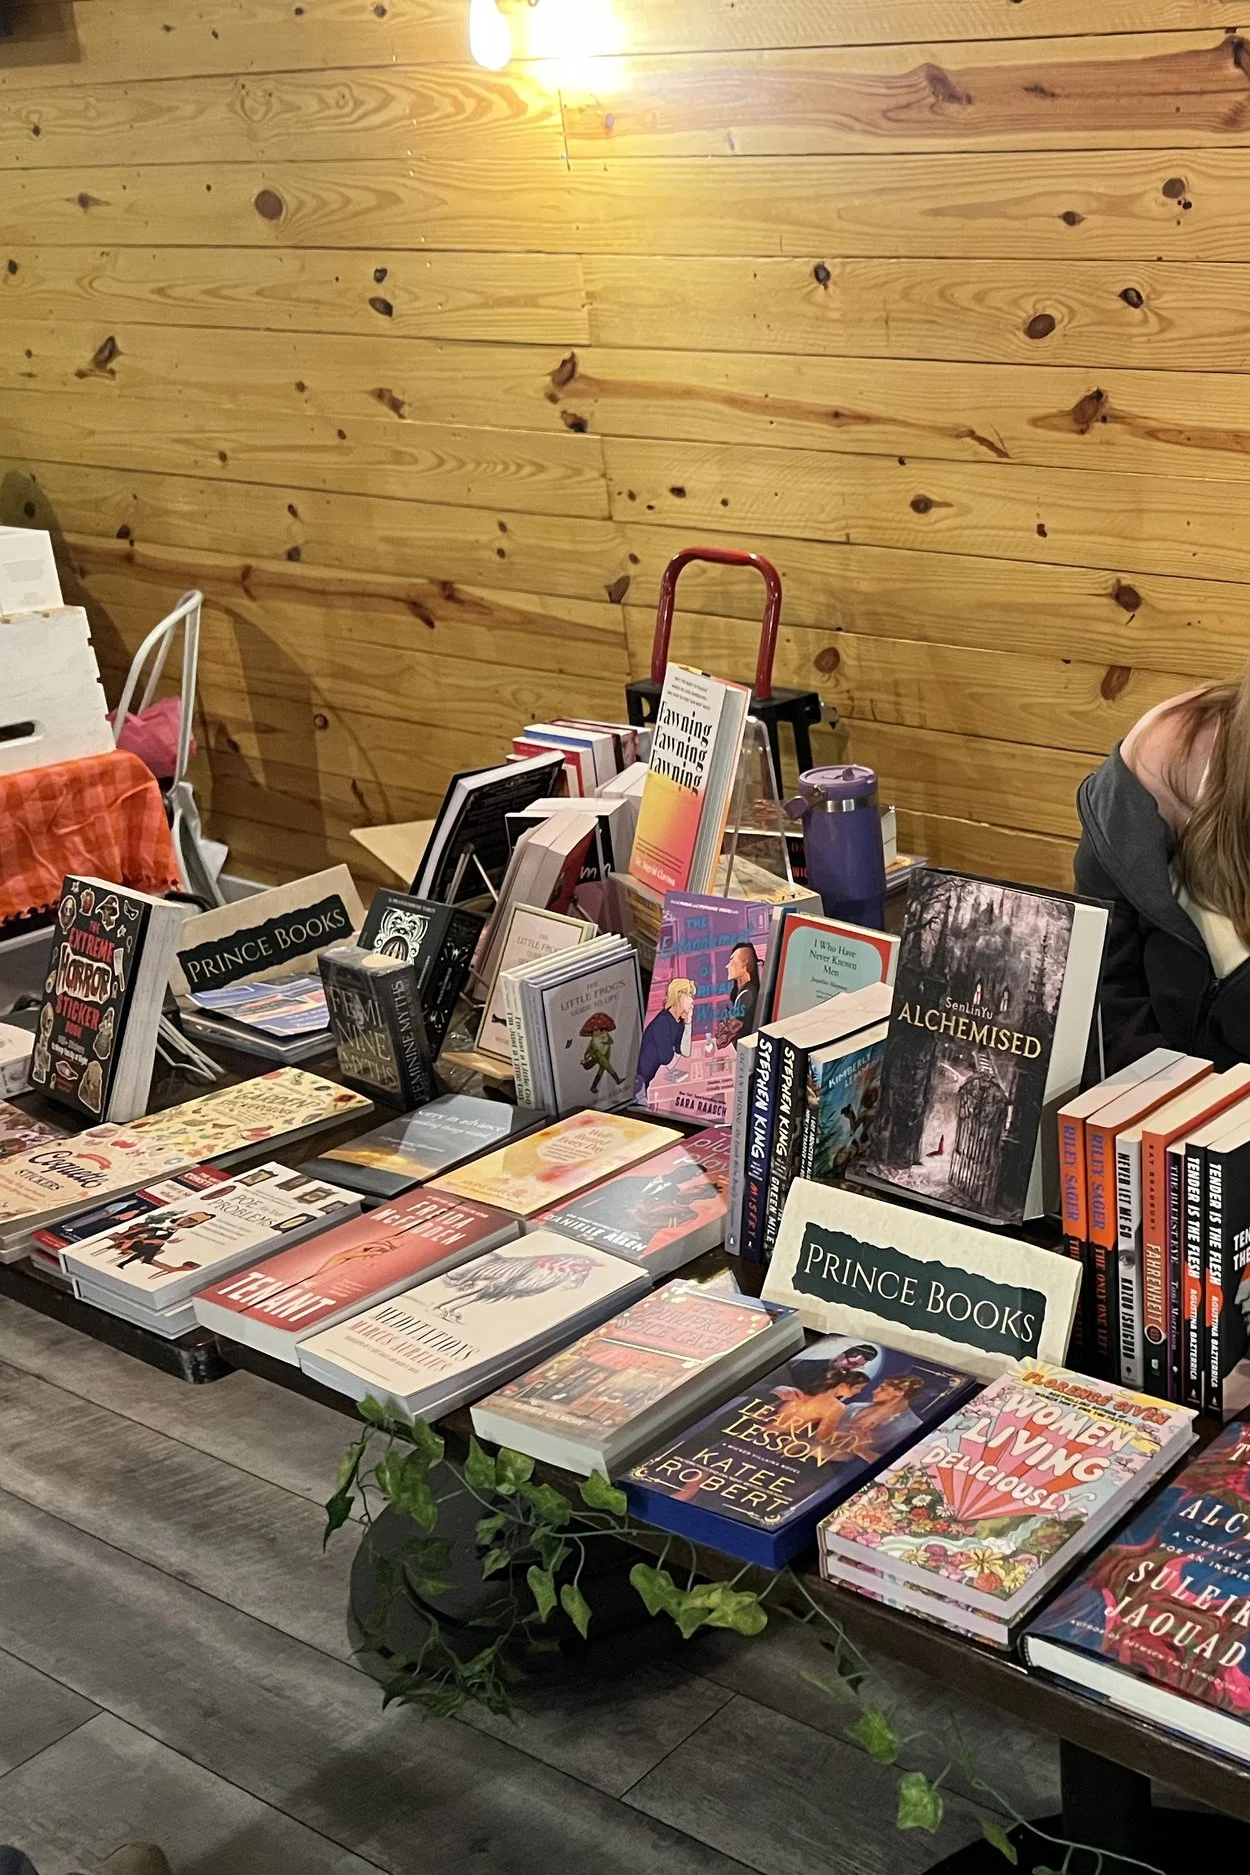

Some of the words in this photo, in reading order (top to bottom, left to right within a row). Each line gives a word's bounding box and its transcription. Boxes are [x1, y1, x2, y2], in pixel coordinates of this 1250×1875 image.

[660, 701, 712, 747] Fawning
[655, 726, 708, 772] Fawning
[650, 750, 702, 797] Fawning
[686, 916, 708, 929] THE
[68, 928, 116, 962] EXTREME
[187, 936, 273, 983] PRINCE
[274, 908, 346, 950] BOOKS
[810, 949, 830, 963] Never
[831, 955, 857, 971] Known
[820, 940, 837, 953] Who
[838, 945, 857, 958] Have
[60, 955, 111, 999] HORROR
[823, 965, 840, 977] Men
[55, 993, 101, 1030] STICKER
[329, 985, 383, 1028] FEMI
[391, 980, 412, 1033] MYTHS
[945, 996, 994, 1021] SenLinYu
[335, 1018, 391, 1061] NINE
[897, 1001, 1042, 1060] ALCHEMISED
[342, 1052, 398, 1087] MYTHS
[755, 1039, 773, 1111] STEPHEN
[780, 1046, 795, 1114] STEPHEN
[828, 1052, 872, 1089] KIMBERLY
[675, 1096, 695, 1110] SARA
[696, 1101, 727, 1117] RAASCH
[750, 1112, 768, 1160] KING
[775, 1115, 791, 1157] KING
[1063, 1124, 1078, 1169] RILEY
[1090, 1132, 1105, 1177] RILEY
[28, 1150, 109, 1189] Coquette
[1116, 1152, 1131, 1186] NEVER
[1187, 1156, 1200, 1198] TENDER
[1208, 1163, 1222, 1207] TENDER
[207, 1198, 275, 1227] PROBLEMS
[231, 1194, 264, 1209] POE
[406, 1201, 475, 1229] FREIDA
[747, 1181, 759, 1239] MISERY
[769, 1176, 780, 1217] GREEN
[1066, 1171, 1081, 1225] SAGER
[1091, 1180, 1106, 1231] SAGER
[1118, 1187, 1131, 1204] LET
[1118, 1205, 1131, 1221] ME
[1187, 1199, 1200, 1214] IS
[1209, 1208, 1222, 1223] IS
[602, 1230, 647, 1253] ALLEN
[766, 1215, 778, 1248] MILE
[1119, 1222, 1132, 1239] GO
[1187, 1215, 1201, 1239] THE
[1208, 1224, 1222, 1248] THE
[1170, 1239, 1179, 1266] EYE
[1187, 1240, 1201, 1280] FLESH
[1208, 1250, 1222, 1287] FLESH
[218, 1271, 337, 1323] TENANT
[803, 1242, 918, 1308] PRINCE
[925, 1280, 1036, 1344] BOOKS
[1120, 1277, 1134, 1315] KAZUO
[1146, 1243, 1162, 1324] FAHRENHEIT
[1170, 1304, 1180, 1350] Morrison
[1189, 1288, 1198, 1328] AGUSTINA
[1211, 1295, 1219, 1333] AGUSTINA
[347, 1320, 398, 1346] MARCUS
[390, 1341, 452, 1372] AURELIUS
[370, 1306, 480, 1361] MEDITATIONS
[1121, 1316, 1136, 1359] ISHIGURO
[1189, 1329, 1198, 1381] BAZTERRICA
[1210, 1334, 1219, 1388] BAZTERRICA
[1022, 1371, 1113, 1406] FLORENCE
[1113, 1400, 1172, 1425] GIVEN
[721, 1415, 841, 1468] LESSON
[738, 1398, 819, 1442] LEARN
[1002, 1393, 1138, 1453] WOMEN
[692, 1448, 795, 1493] KATEE
[963, 1416, 1112, 1483] LIVING
[655, 1460, 789, 1511] ROBERT
[921, 1446, 1084, 1514] DELICIOUSLY
[1158, 1542, 1184, 1555] FOR
[1188, 1553, 1205, 1563] AN
[1185, 1535, 1244, 1561] CREATIVE
[1104, 1596, 1250, 1668] JAOUAD
